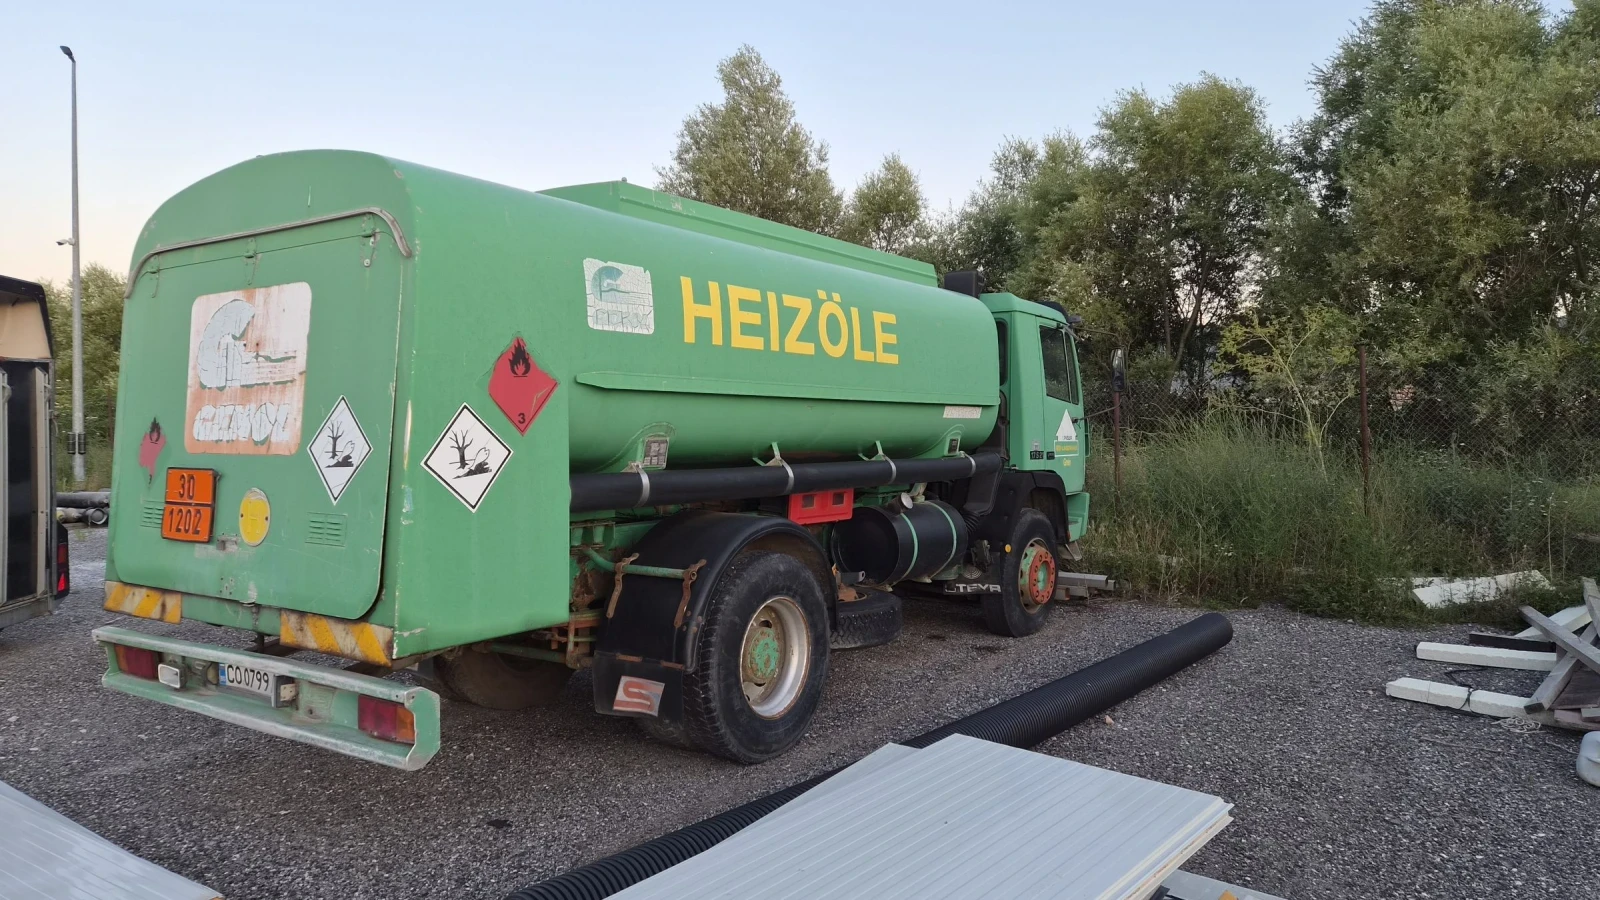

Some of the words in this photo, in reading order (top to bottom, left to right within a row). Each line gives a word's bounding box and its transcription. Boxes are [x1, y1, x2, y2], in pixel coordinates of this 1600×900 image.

[680, 275, 899, 364] HEIZÖLE
[517, 412, 526, 425] 3
[178, 474, 196, 500] 30
[168, 507, 202, 535] 1202
[226, 664, 242, 685] CO
[243, 667, 269, 692] 0799
